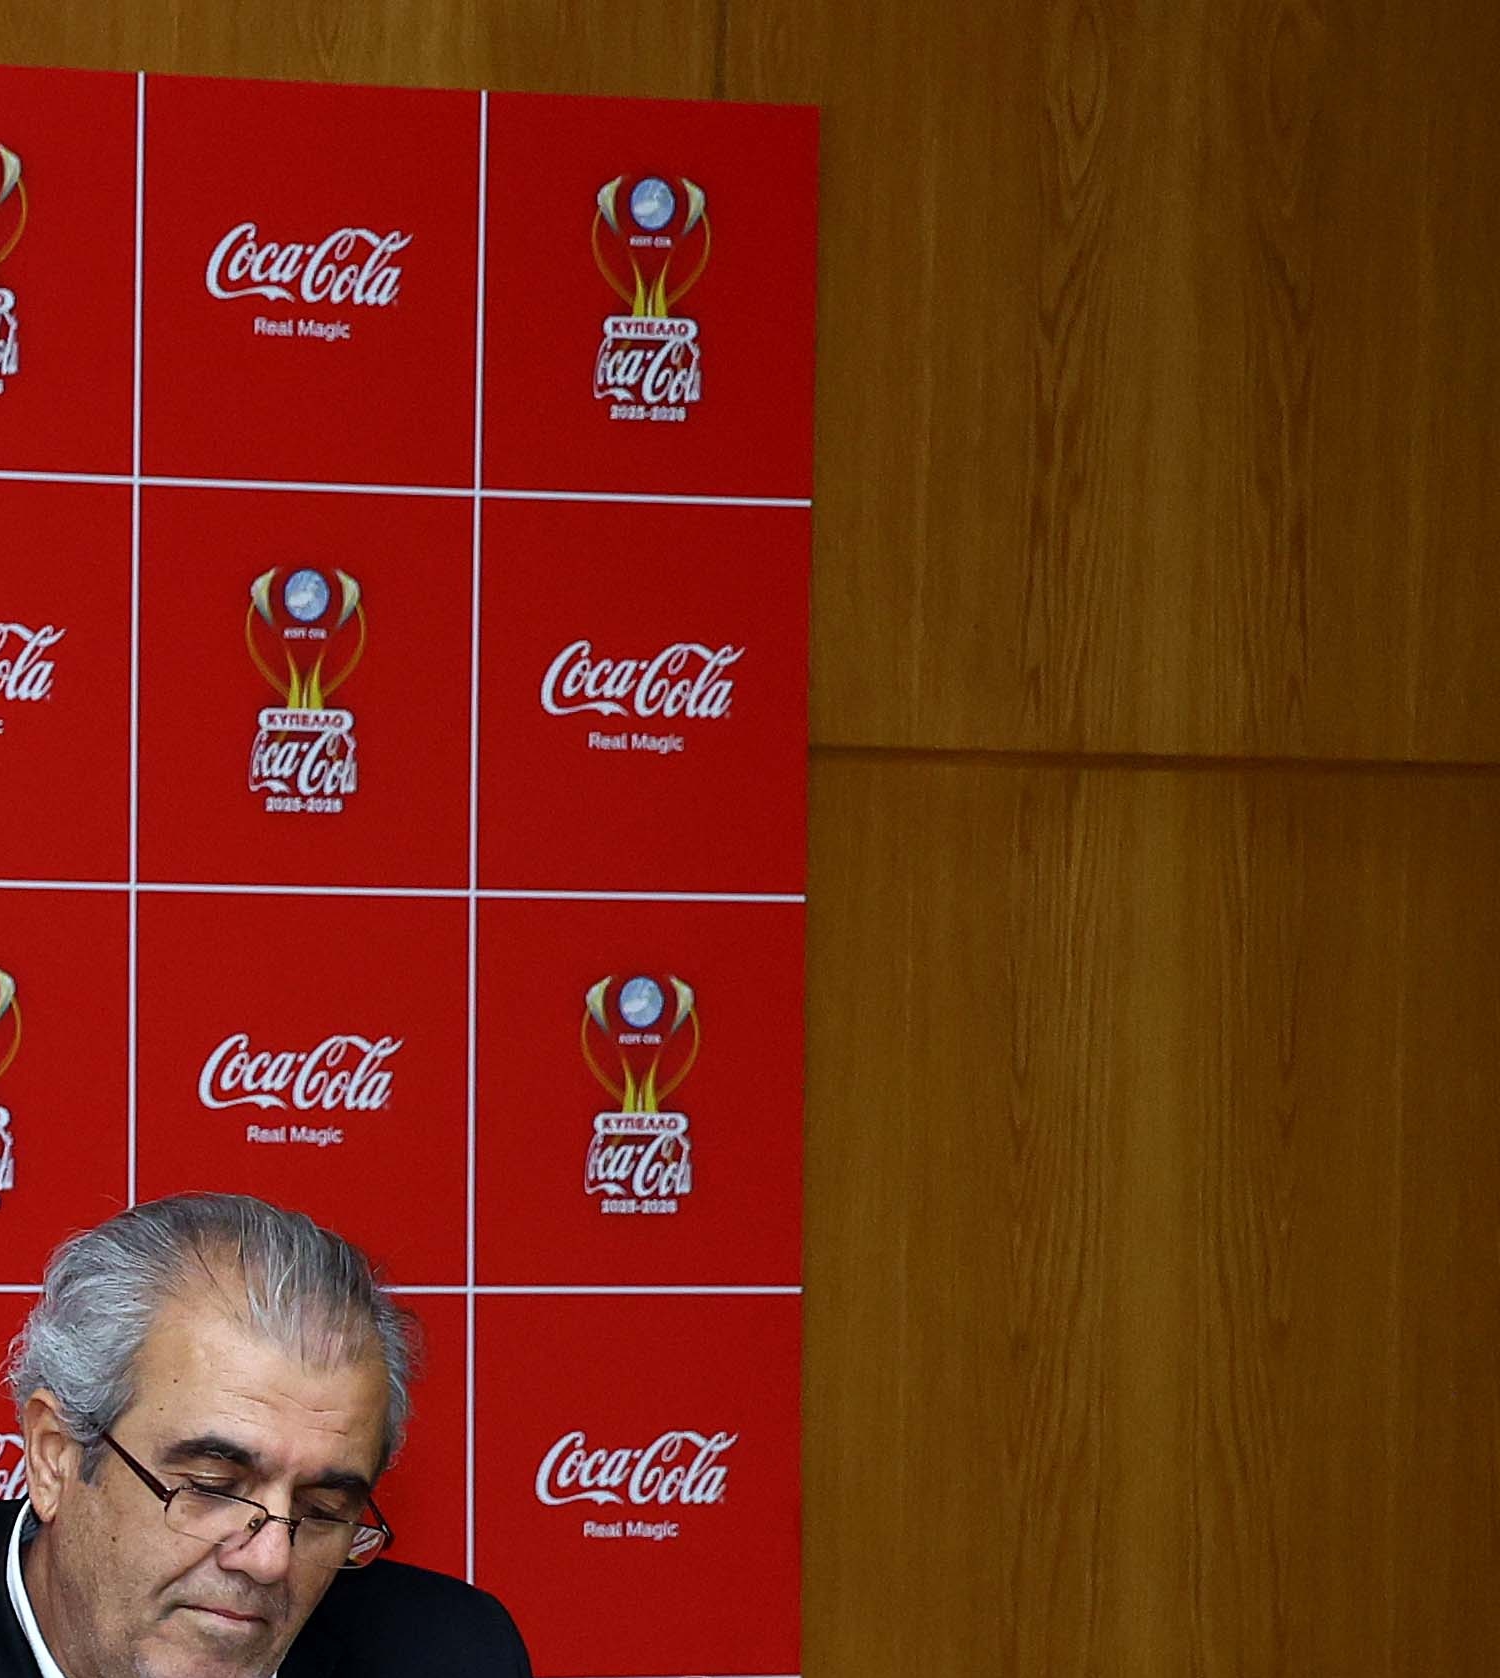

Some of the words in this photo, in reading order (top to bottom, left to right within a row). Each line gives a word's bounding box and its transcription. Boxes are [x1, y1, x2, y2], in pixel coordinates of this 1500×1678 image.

[205, 222, 413, 306] Coca-Cola
[254, 317, 293, 336] Real
[297, 319, 350, 341] Magic
[540, 640, 745, 718] Coca-Cola
[588, 732, 627, 749] Real
[630, 733, 683, 754] Magic
[198, 1033, 404, 1110] Coca-Cola
[246, 1125, 286, 1142] Real
[289, 1125, 342, 1146] Magic
[535, 1430, 738, 1505] Coca-Cola
[583, 1520, 622, 1538] Real
[625, 1520, 678, 1540] Magic
